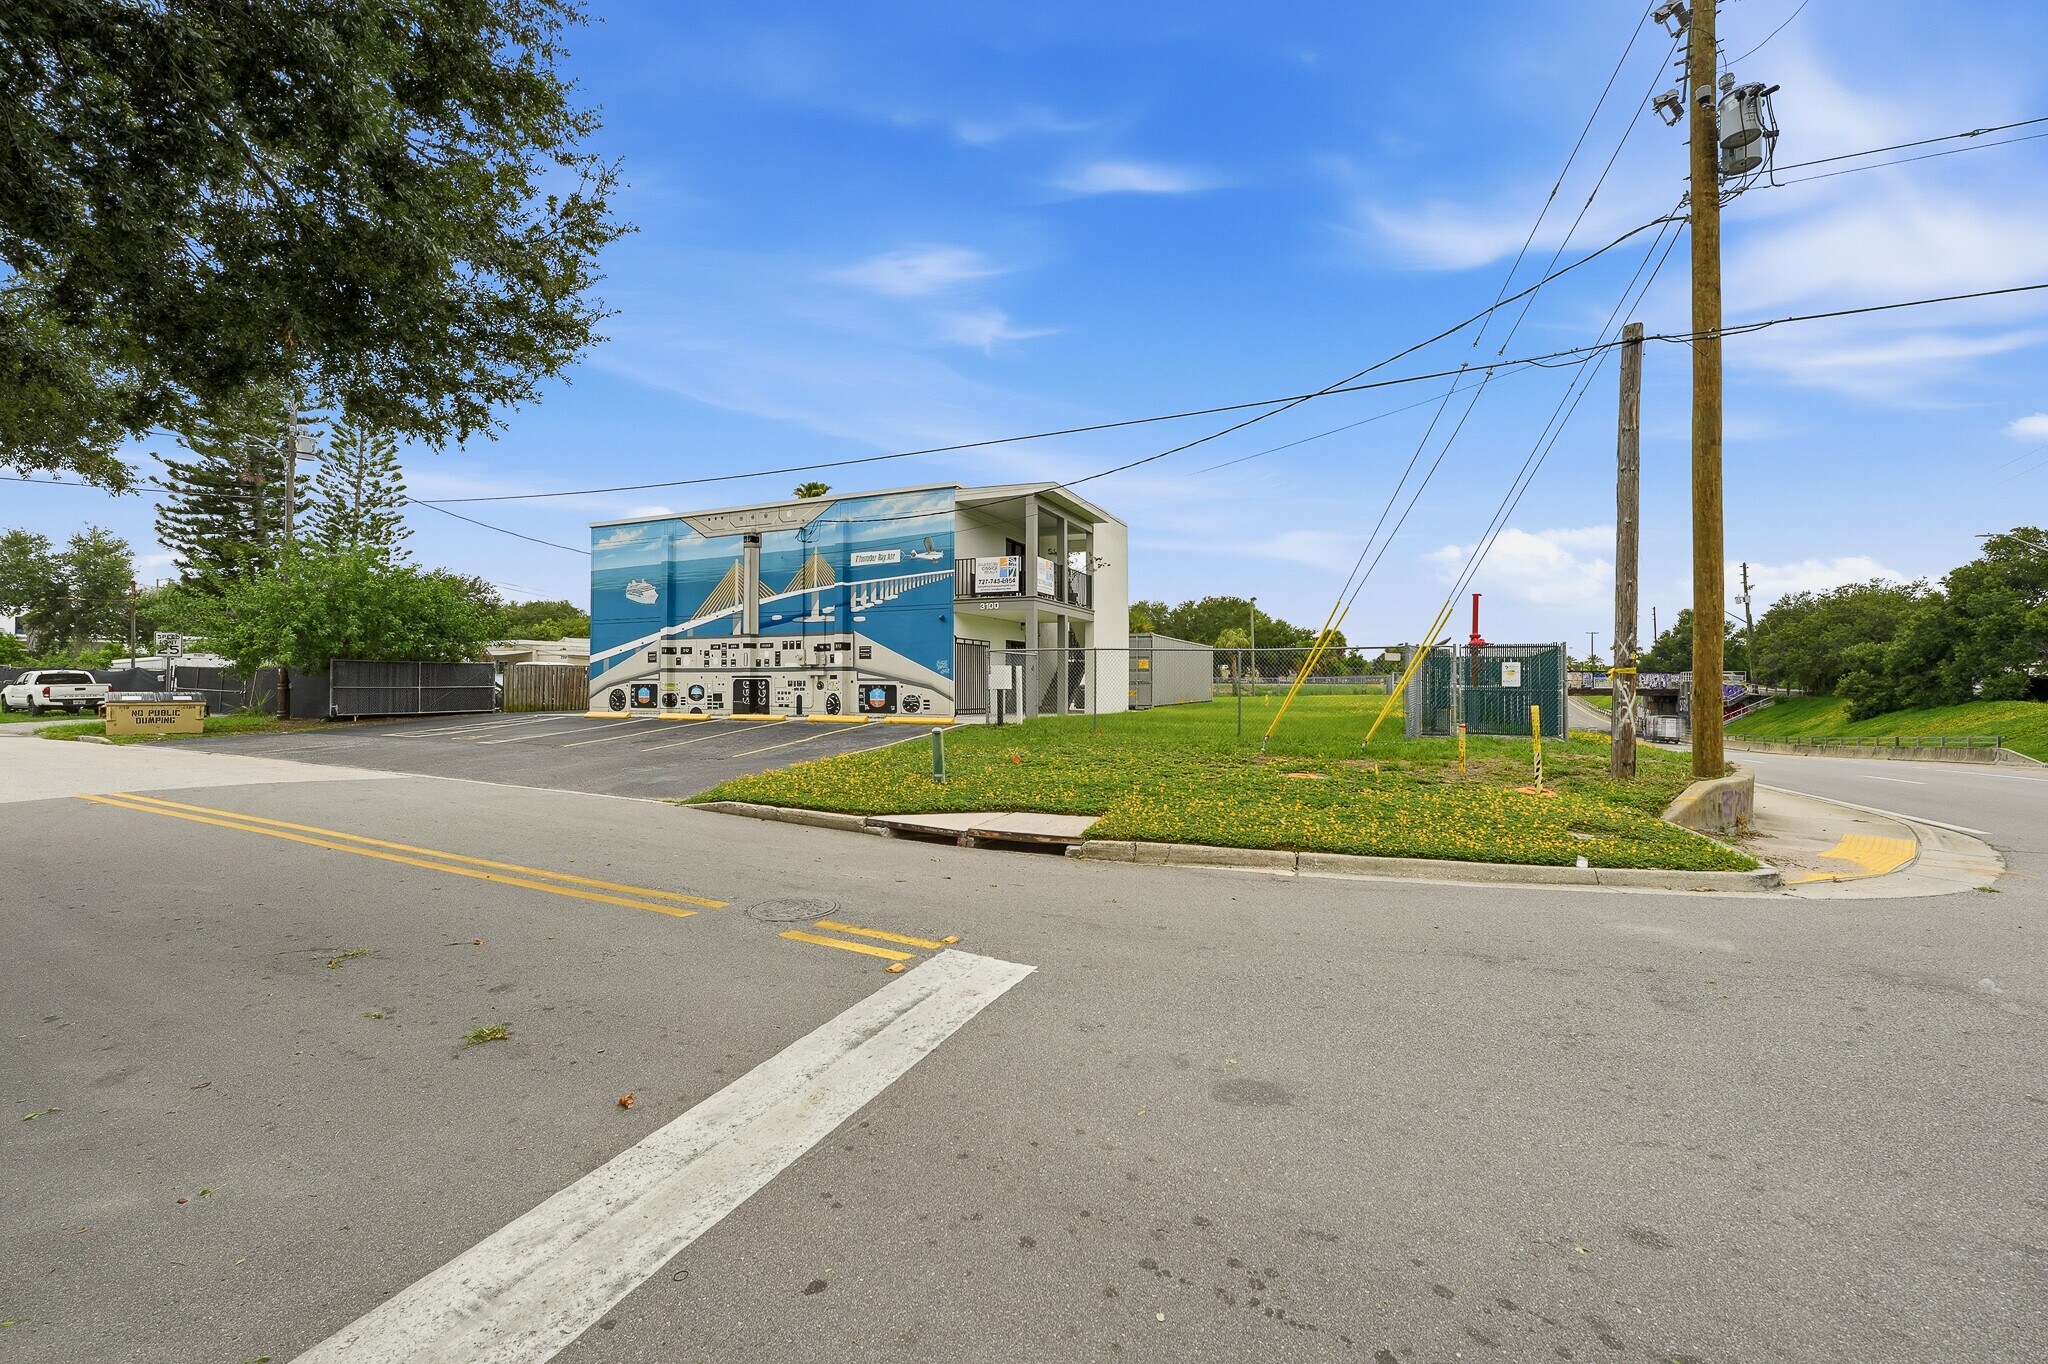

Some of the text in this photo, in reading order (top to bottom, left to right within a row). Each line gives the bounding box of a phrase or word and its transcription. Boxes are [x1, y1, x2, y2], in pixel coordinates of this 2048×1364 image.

[855, 554, 877, 563] Thunder
[877, 553, 887, 562] Bay
[979, 602, 999, 610] 3100
[148, 709, 181, 717] PUBLIC
[135, 717, 176, 725] DUMPING
